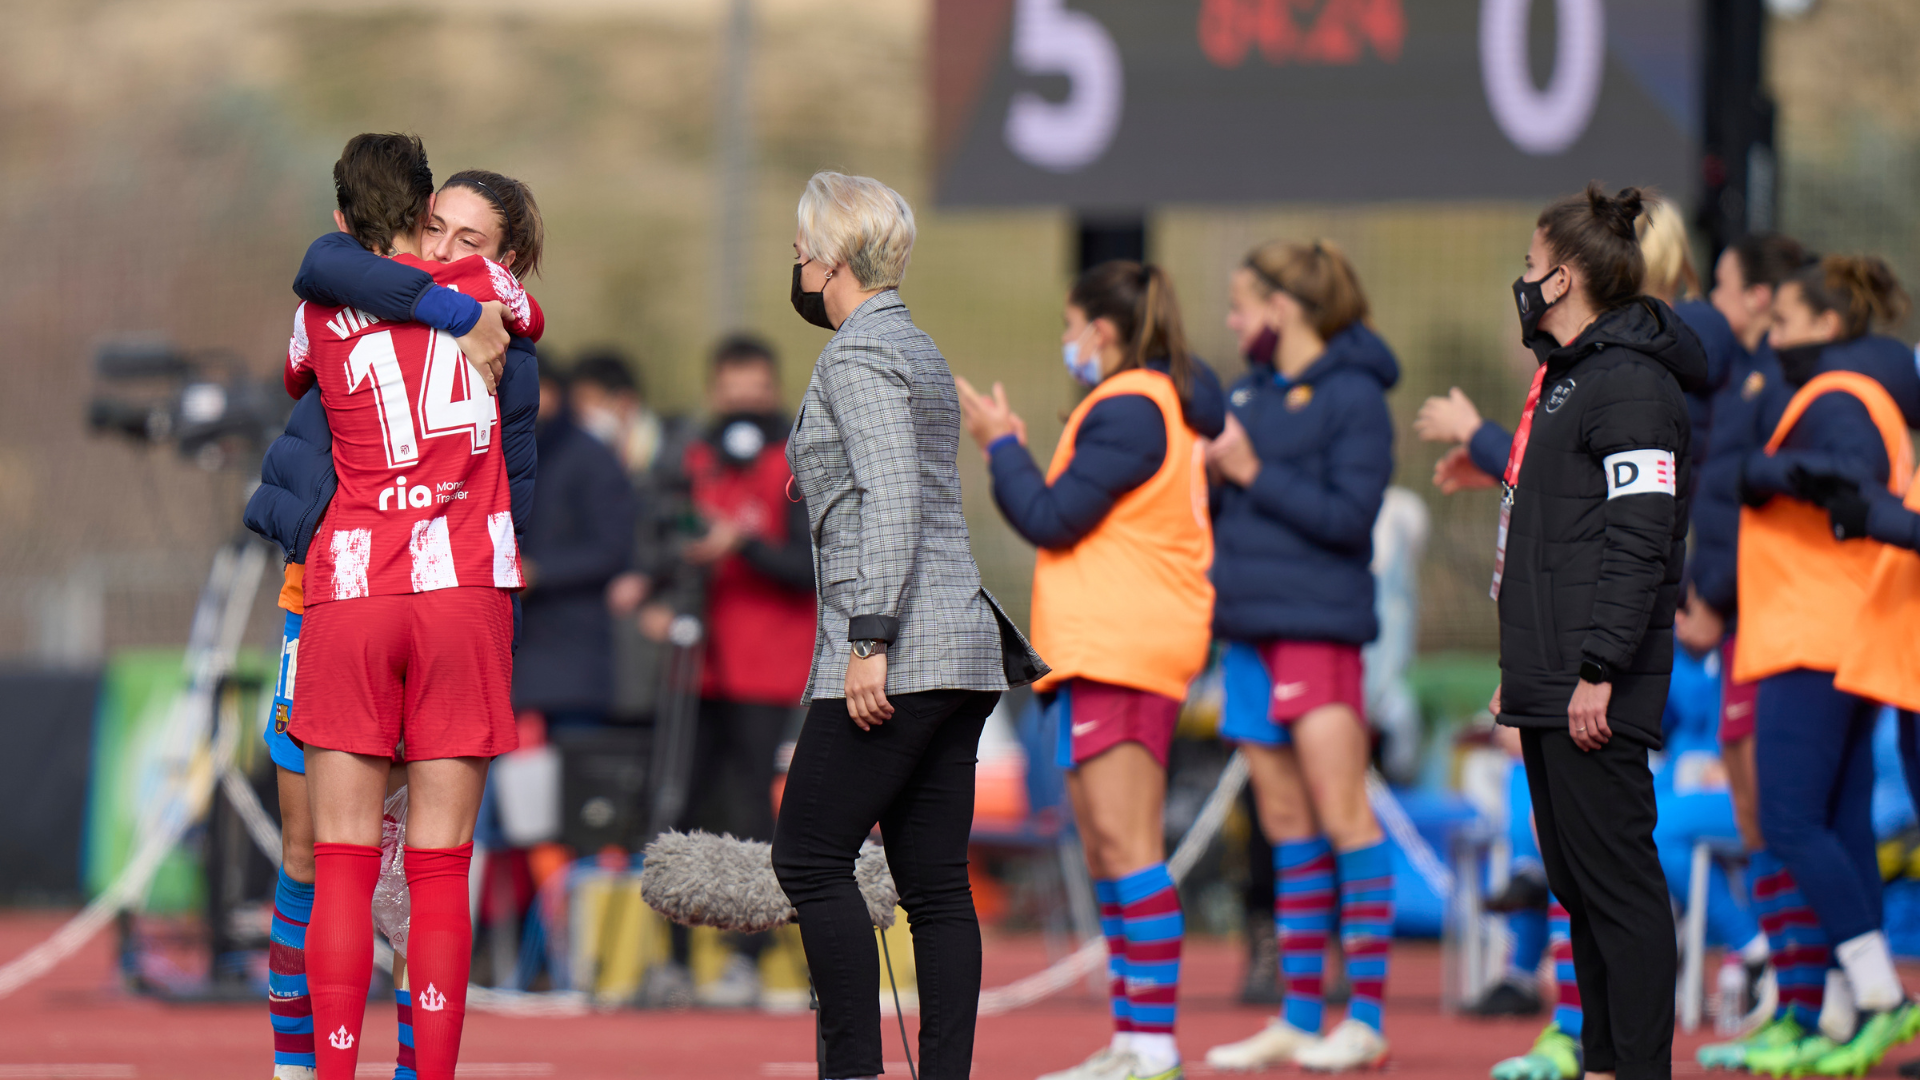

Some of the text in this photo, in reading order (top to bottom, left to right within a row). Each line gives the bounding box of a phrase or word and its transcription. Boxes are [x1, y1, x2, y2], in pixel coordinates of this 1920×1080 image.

[1005, 0, 1123, 170] 5
[1479, 0, 1604, 153] 0
[344, 327, 498, 469] 14
[379, 475, 432, 511] ria
[1613, 461, 1639, 489] D
